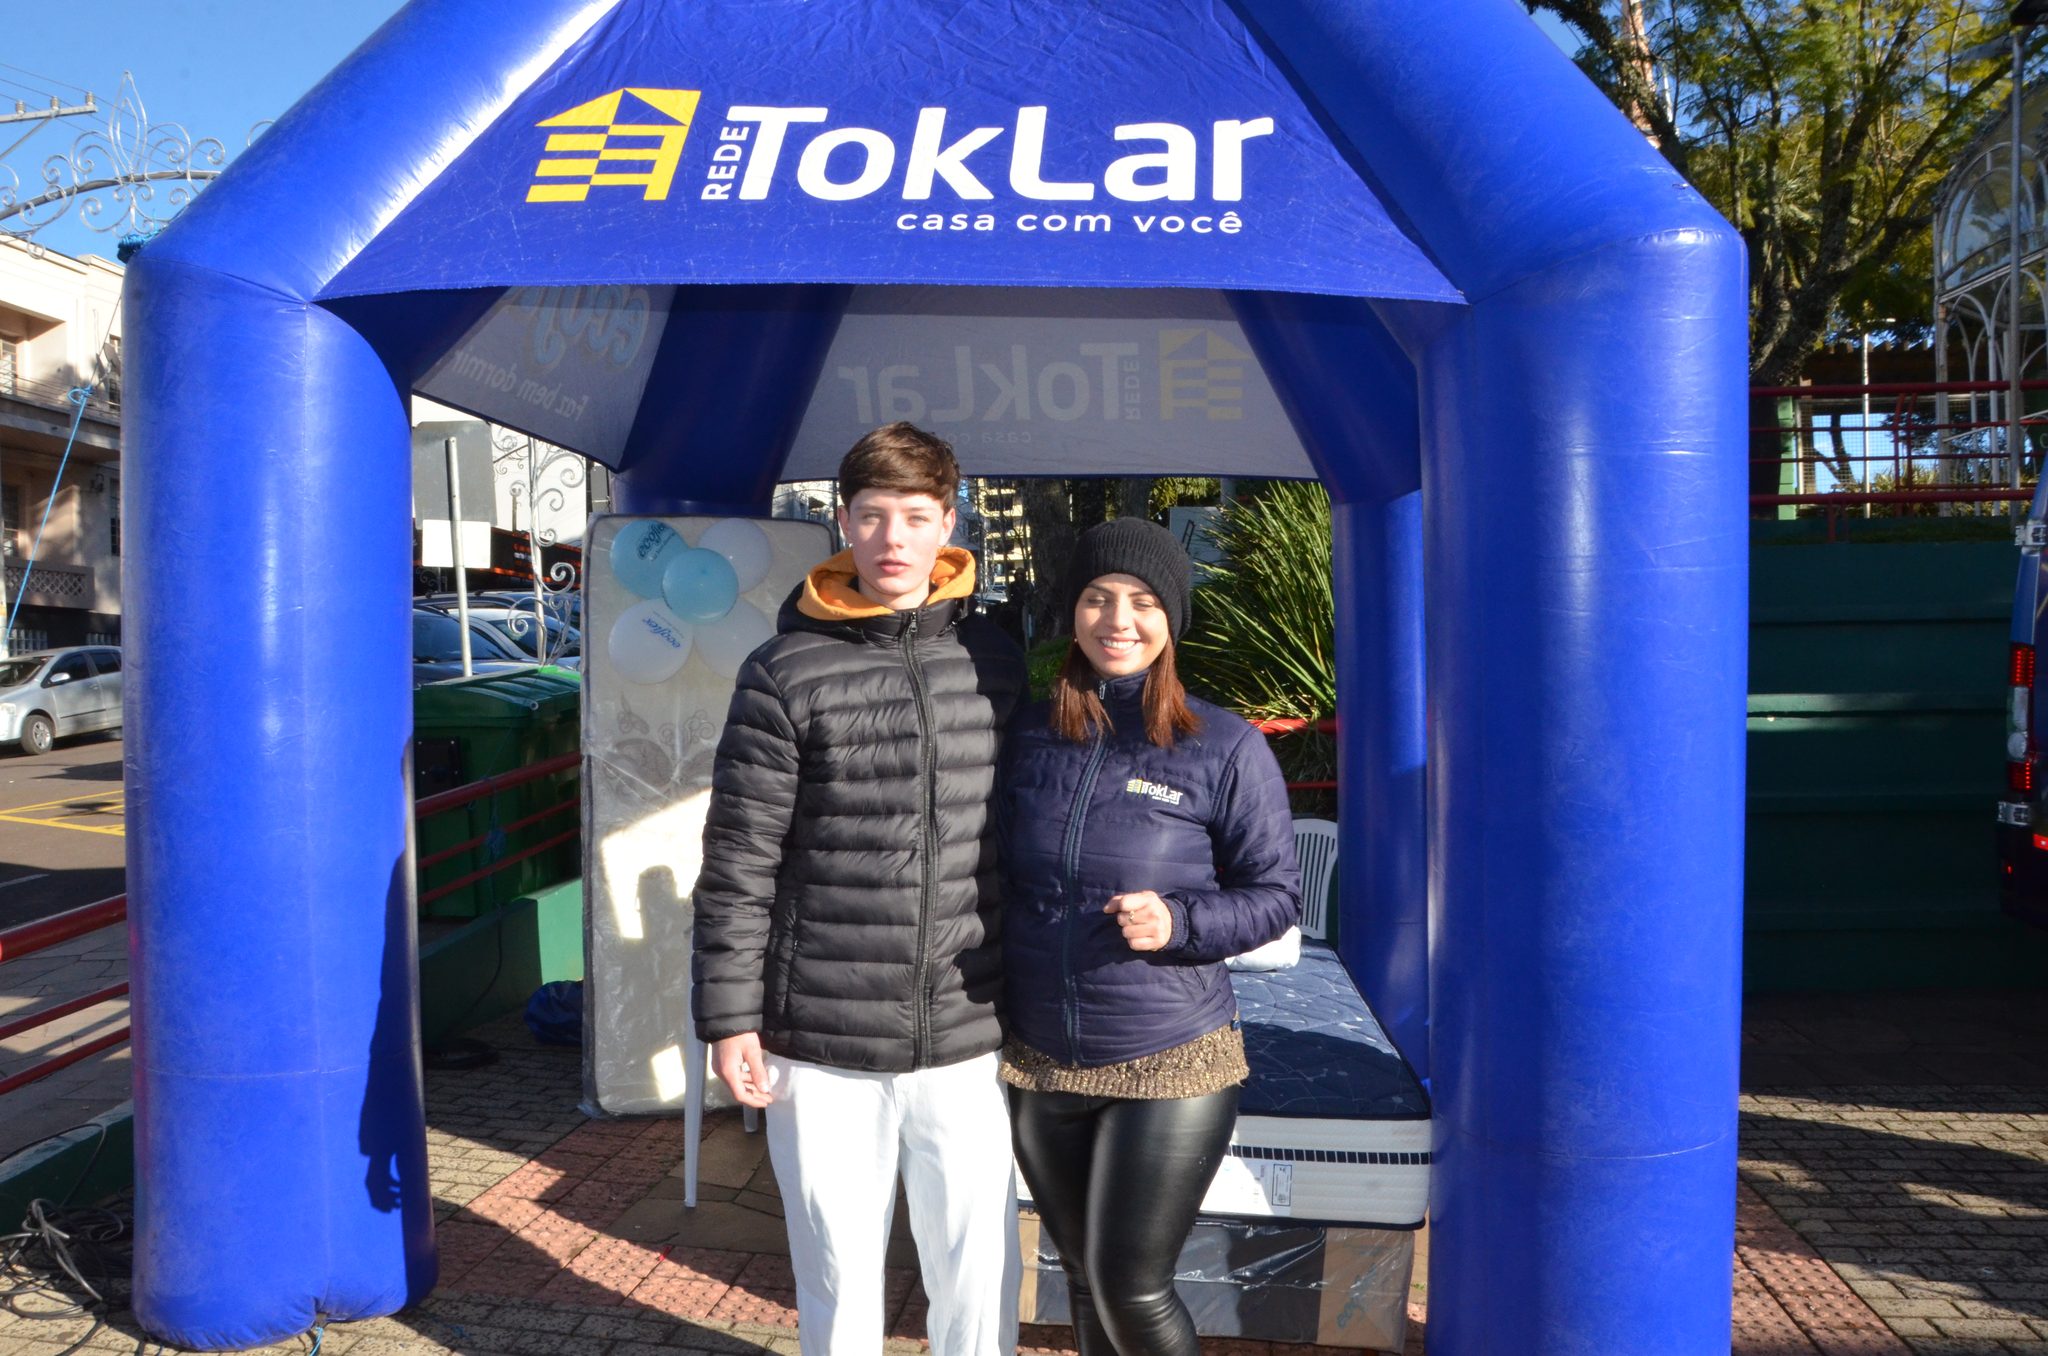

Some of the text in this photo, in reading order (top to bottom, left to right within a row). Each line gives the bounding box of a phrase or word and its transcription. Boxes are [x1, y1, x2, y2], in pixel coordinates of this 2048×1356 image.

[701, 105, 1274, 202] REDE TokLar
[896, 211, 1243, 234] casa com você
